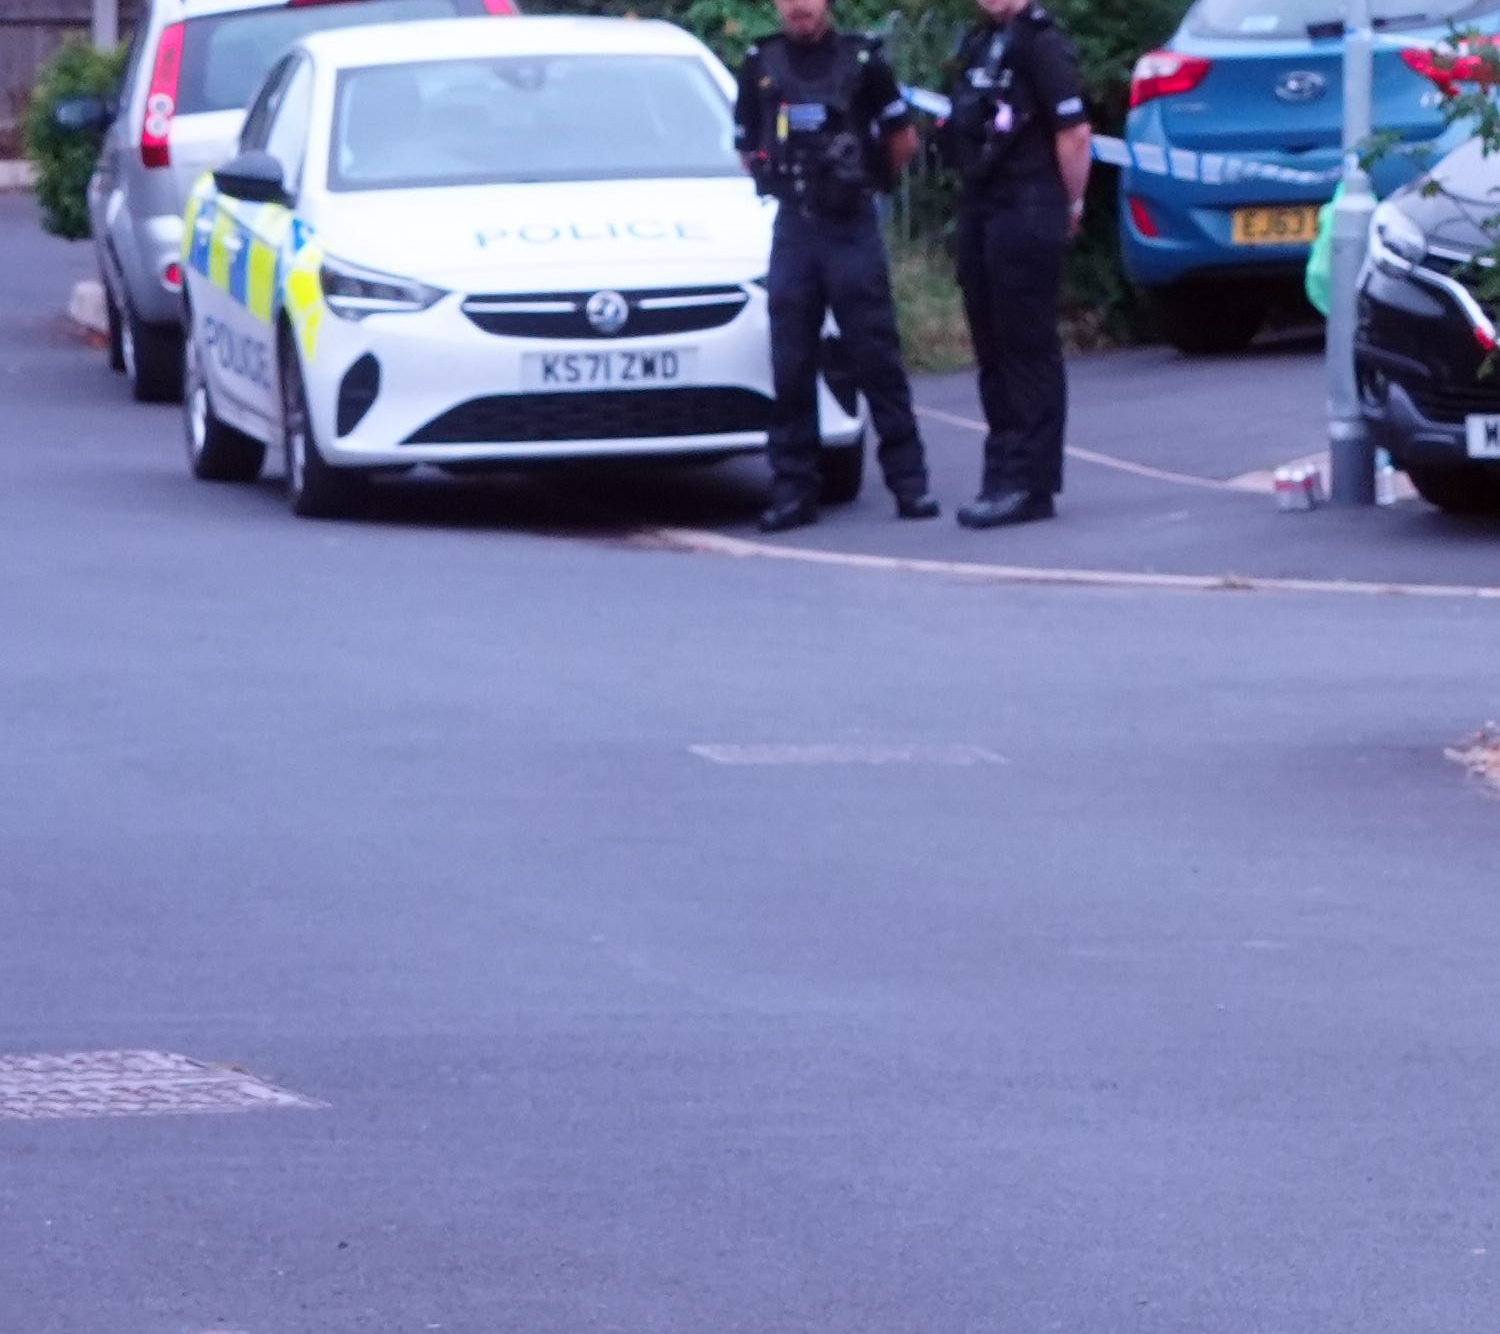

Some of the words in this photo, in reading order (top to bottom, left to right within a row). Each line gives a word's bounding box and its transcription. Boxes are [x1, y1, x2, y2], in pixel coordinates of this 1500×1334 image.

[476, 222, 711, 248] POLICE
[206, 317, 272, 390] POLICE
[542, 352, 611, 383] KS71
[620, 350, 679, 381] ZWD
